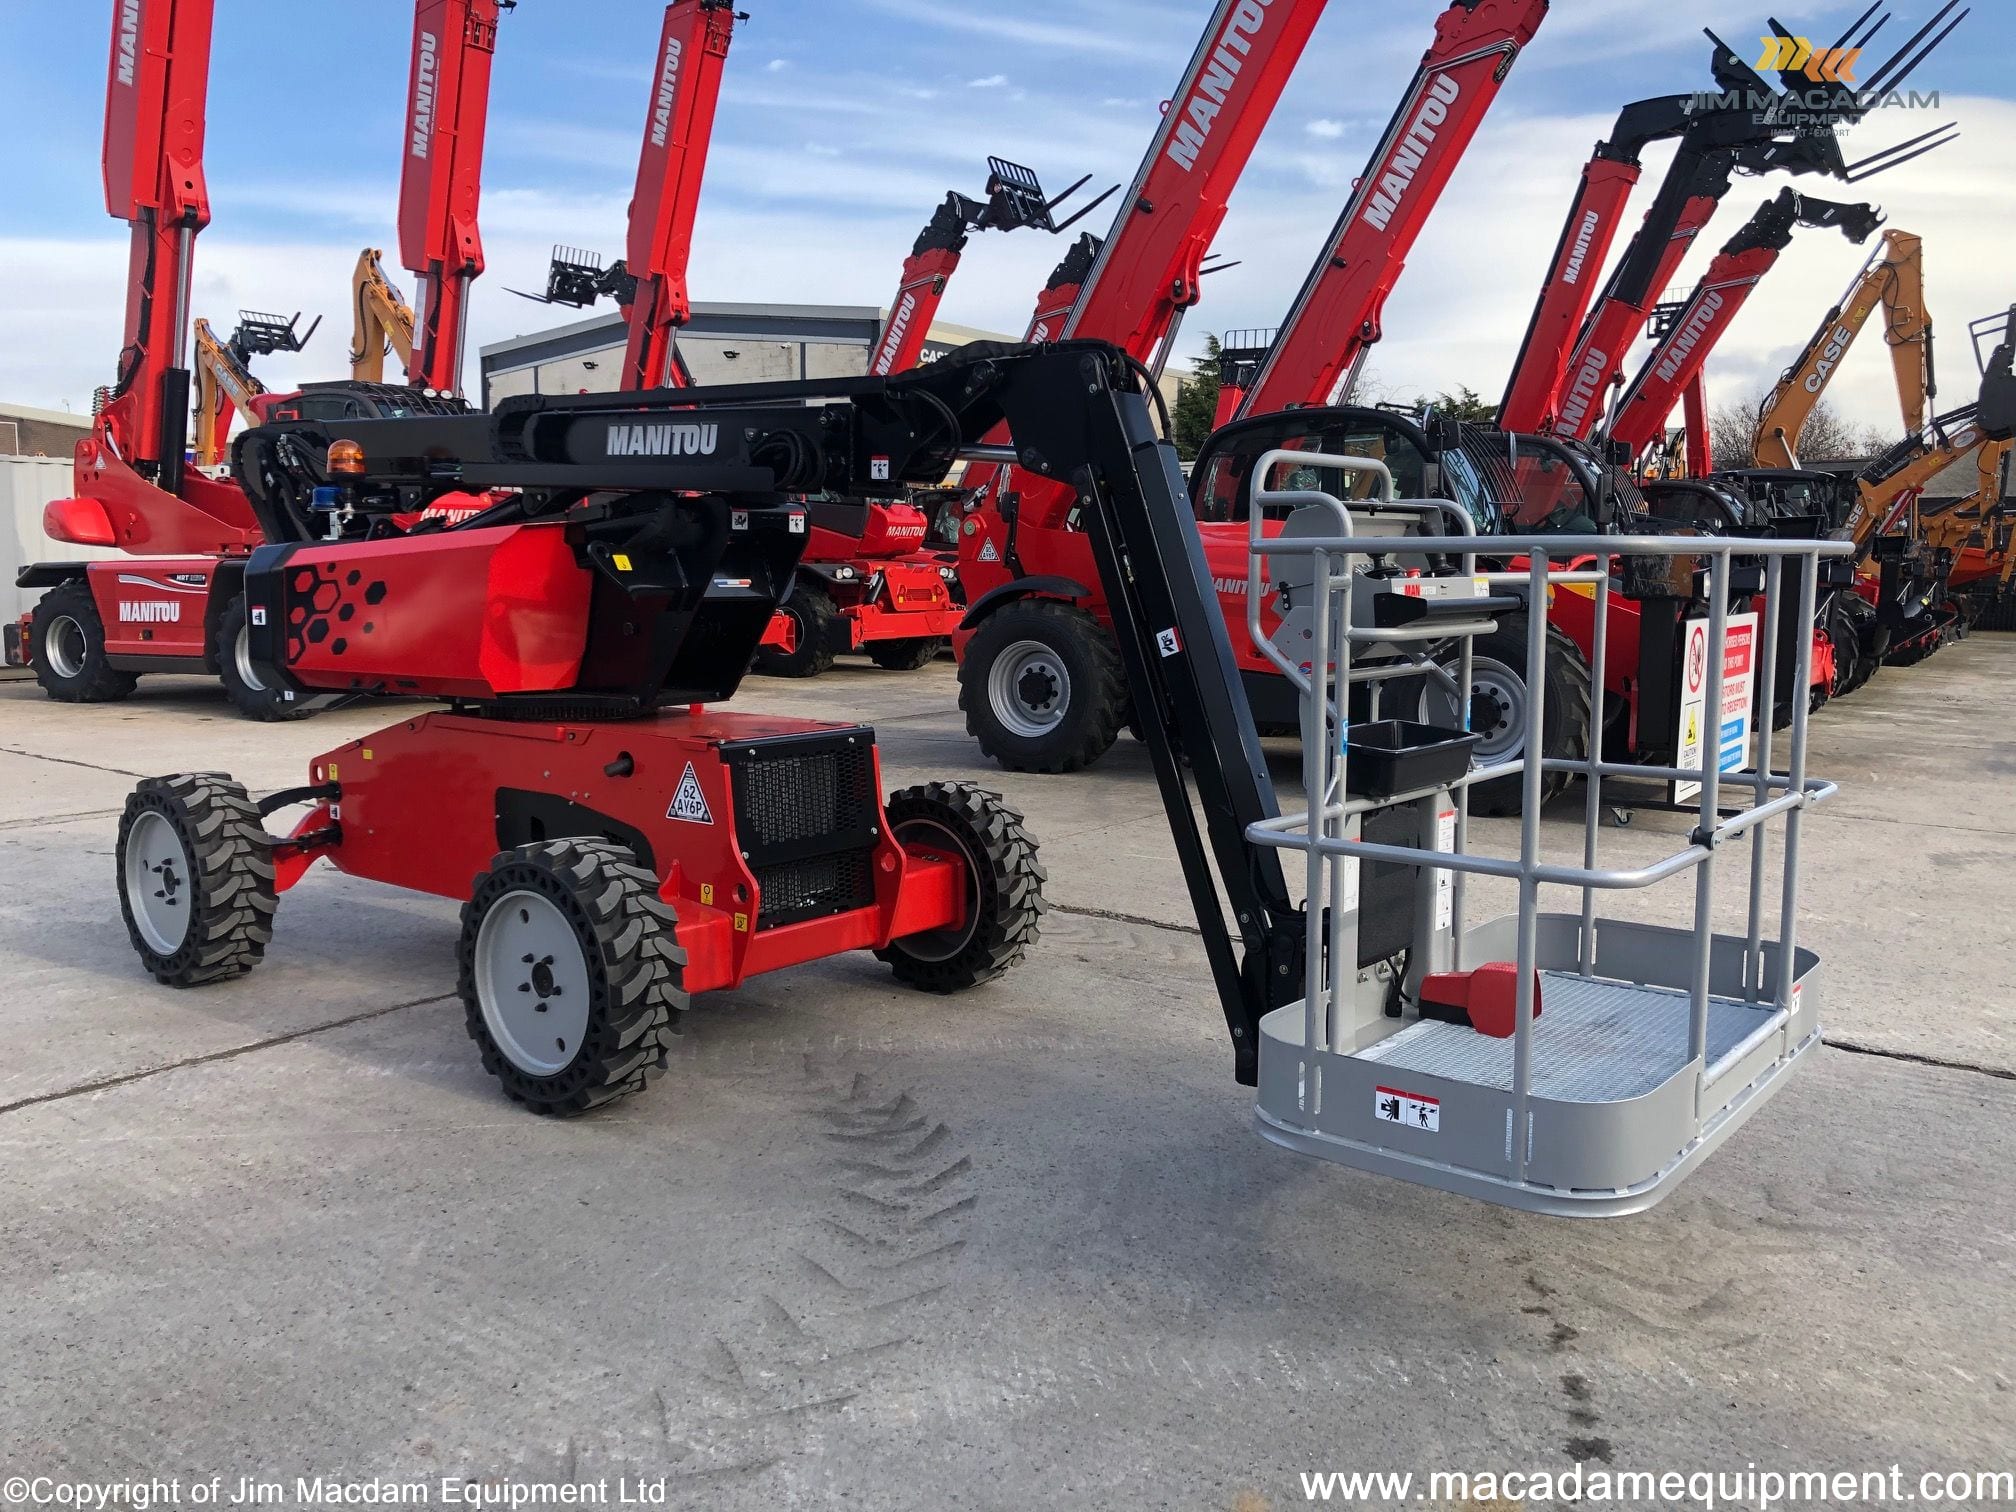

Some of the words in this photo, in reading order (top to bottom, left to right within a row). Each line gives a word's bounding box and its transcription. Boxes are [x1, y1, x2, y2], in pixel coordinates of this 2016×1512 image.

[118, 0, 139, 87] MANI
[411, 31, 436, 160] MANITOU
[651, 36, 682, 148] MANITOU
[1362, 72, 1460, 232] MANITOU
[1562, 209, 1599, 285] MANITOU
[876, 291, 916, 376] MANITOU
[1655, 290, 1724, 384] MANITOU
[1804, 325, 1852, 393] CASE
[1555, 346, 1608, 437] ANITOU
[607, 423, 718, 456] MANITOU
[885, 526, 927, 537] MANITOU
[119, 601, 180, 622] MANITOU
[1212, 577, 1271, 597] ANITU
[677, 799, 702, 815] AY6P
[683, 785, 696, 799] 62
